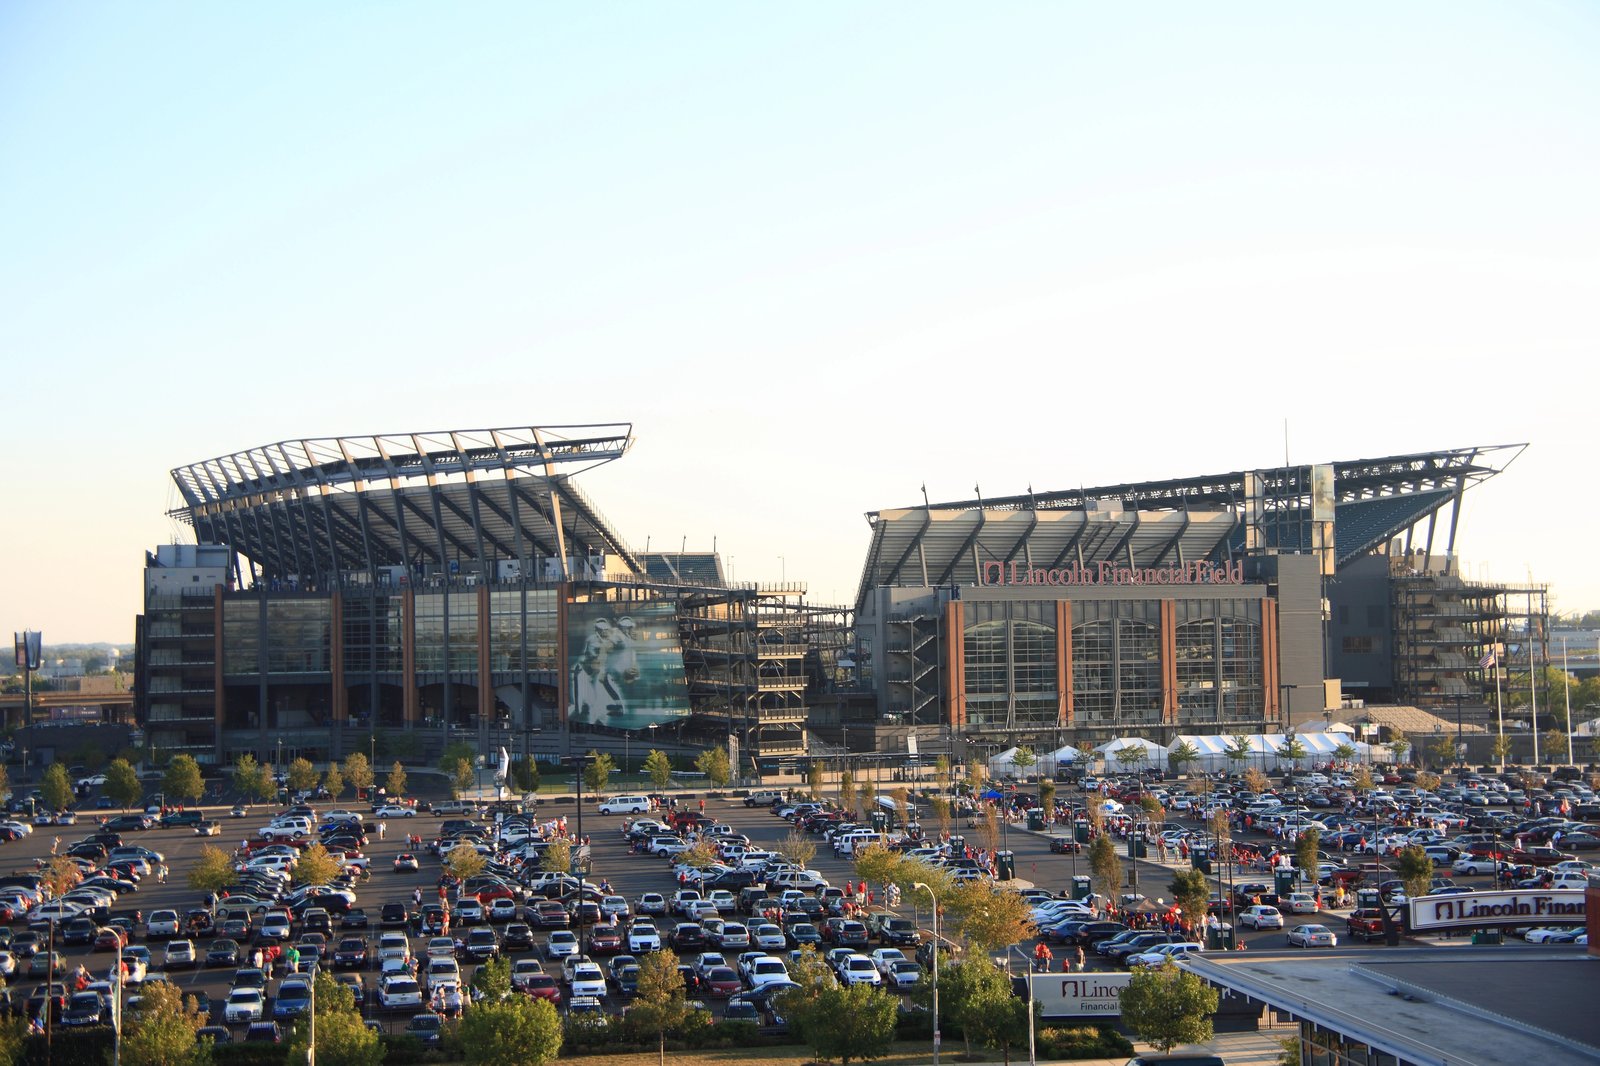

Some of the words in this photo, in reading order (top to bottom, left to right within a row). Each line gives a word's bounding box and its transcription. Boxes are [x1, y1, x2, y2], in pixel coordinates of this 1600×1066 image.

[1009, 560, 1093, 586] Lincoln
[1097, 560, 1192, 586] Financial
[1194, 560, 1245, 585] Field
[1457, 897, 1530, 918] Lincoln
[1080, 1002, 1118, 1011] Financial
